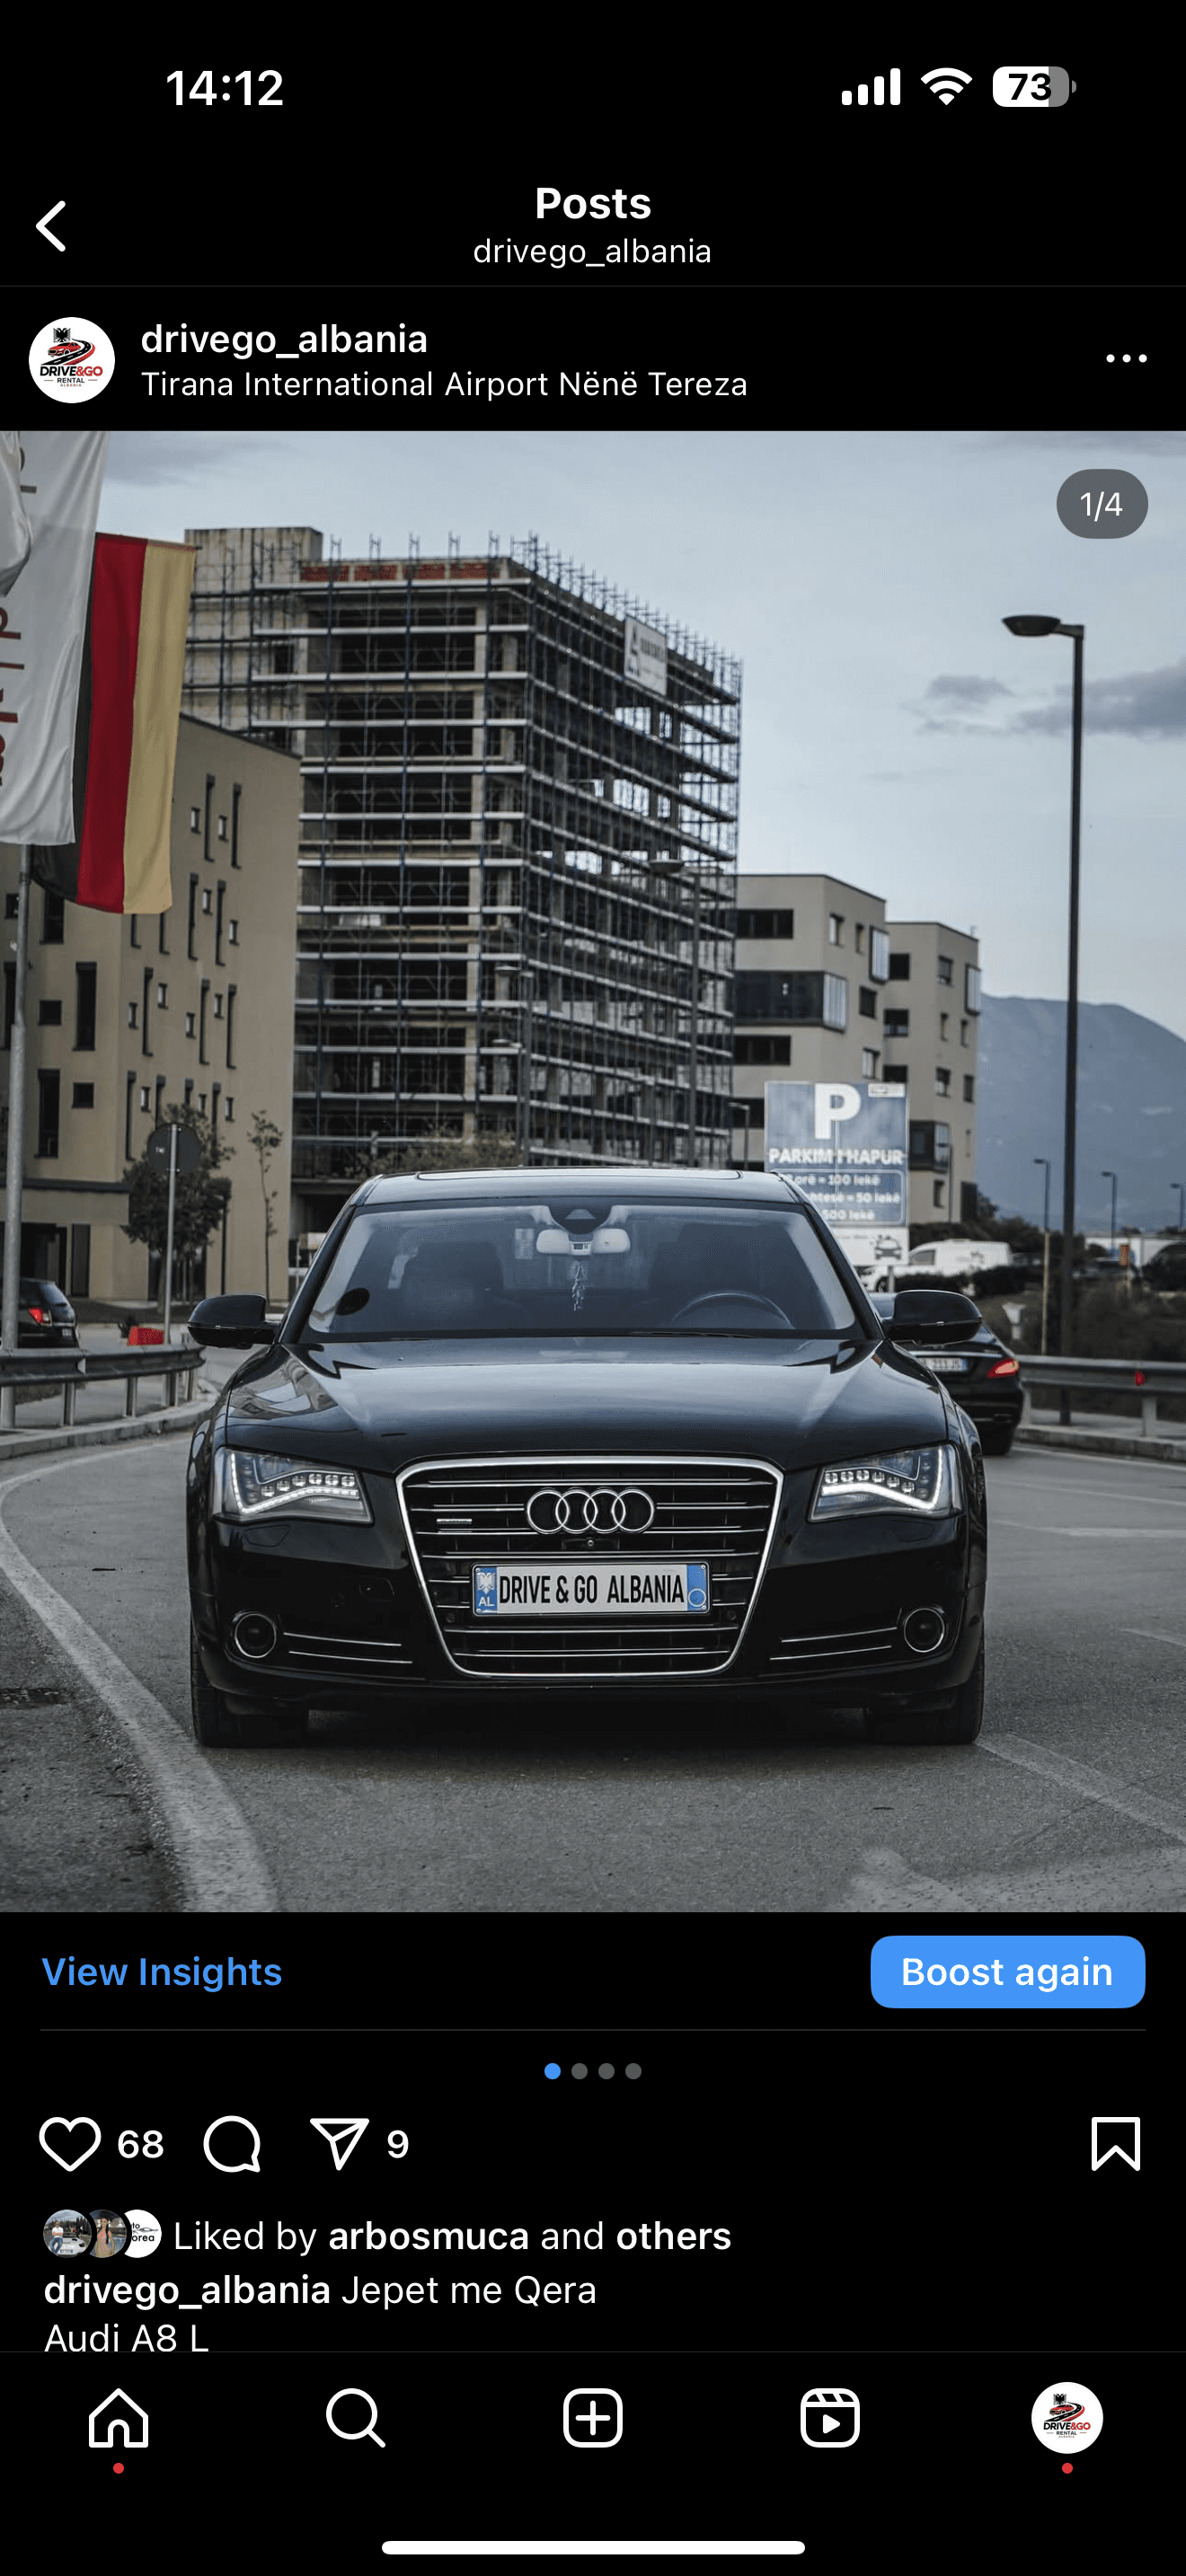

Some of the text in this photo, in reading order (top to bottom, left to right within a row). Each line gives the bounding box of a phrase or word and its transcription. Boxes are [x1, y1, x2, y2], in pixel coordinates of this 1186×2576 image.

[166, 70, 283, 106] 14:12
[1009, 73, 1052, 101] 73
[536, 187, 651, 220] Posts
[474, 237, 711, 269] drivego_albania
[141, 322, 427, 360] drivego_albania
[40, 366, 103, 376] DRIVE&GO
[141, 370, 747, 401] Tirana International Airport Nënë Tereza
[1080, 491, 1123, 522] 1/4
[814, 1083, 861, 1140] P
[768, 1148, 834, 1164] PARKIM
[846, 1149, 904, 1165] HAPUR
[828, 1173, 852, 1187] 100
[478, 1596, 495, 1608] AL
[500, 1574, 685, 1604] DRIVE & GO ALBANIA
[41, 1955, 282, 1993] View Insights
[902, 1955, 1113, 1993] Boost again
[118, 2130, 164, 2159] 68
[387, 2130, 409, 2159] 9
[175, 2220, 731, 2257] Liked by arbosmuca and others
[44, 2273, 596, 2311] drivego_albania Jepet me Qera
[44, 2323, 209, 2352] Audi A8 L
[1043, 2422, 1091, 2430] DRIVE&GO
